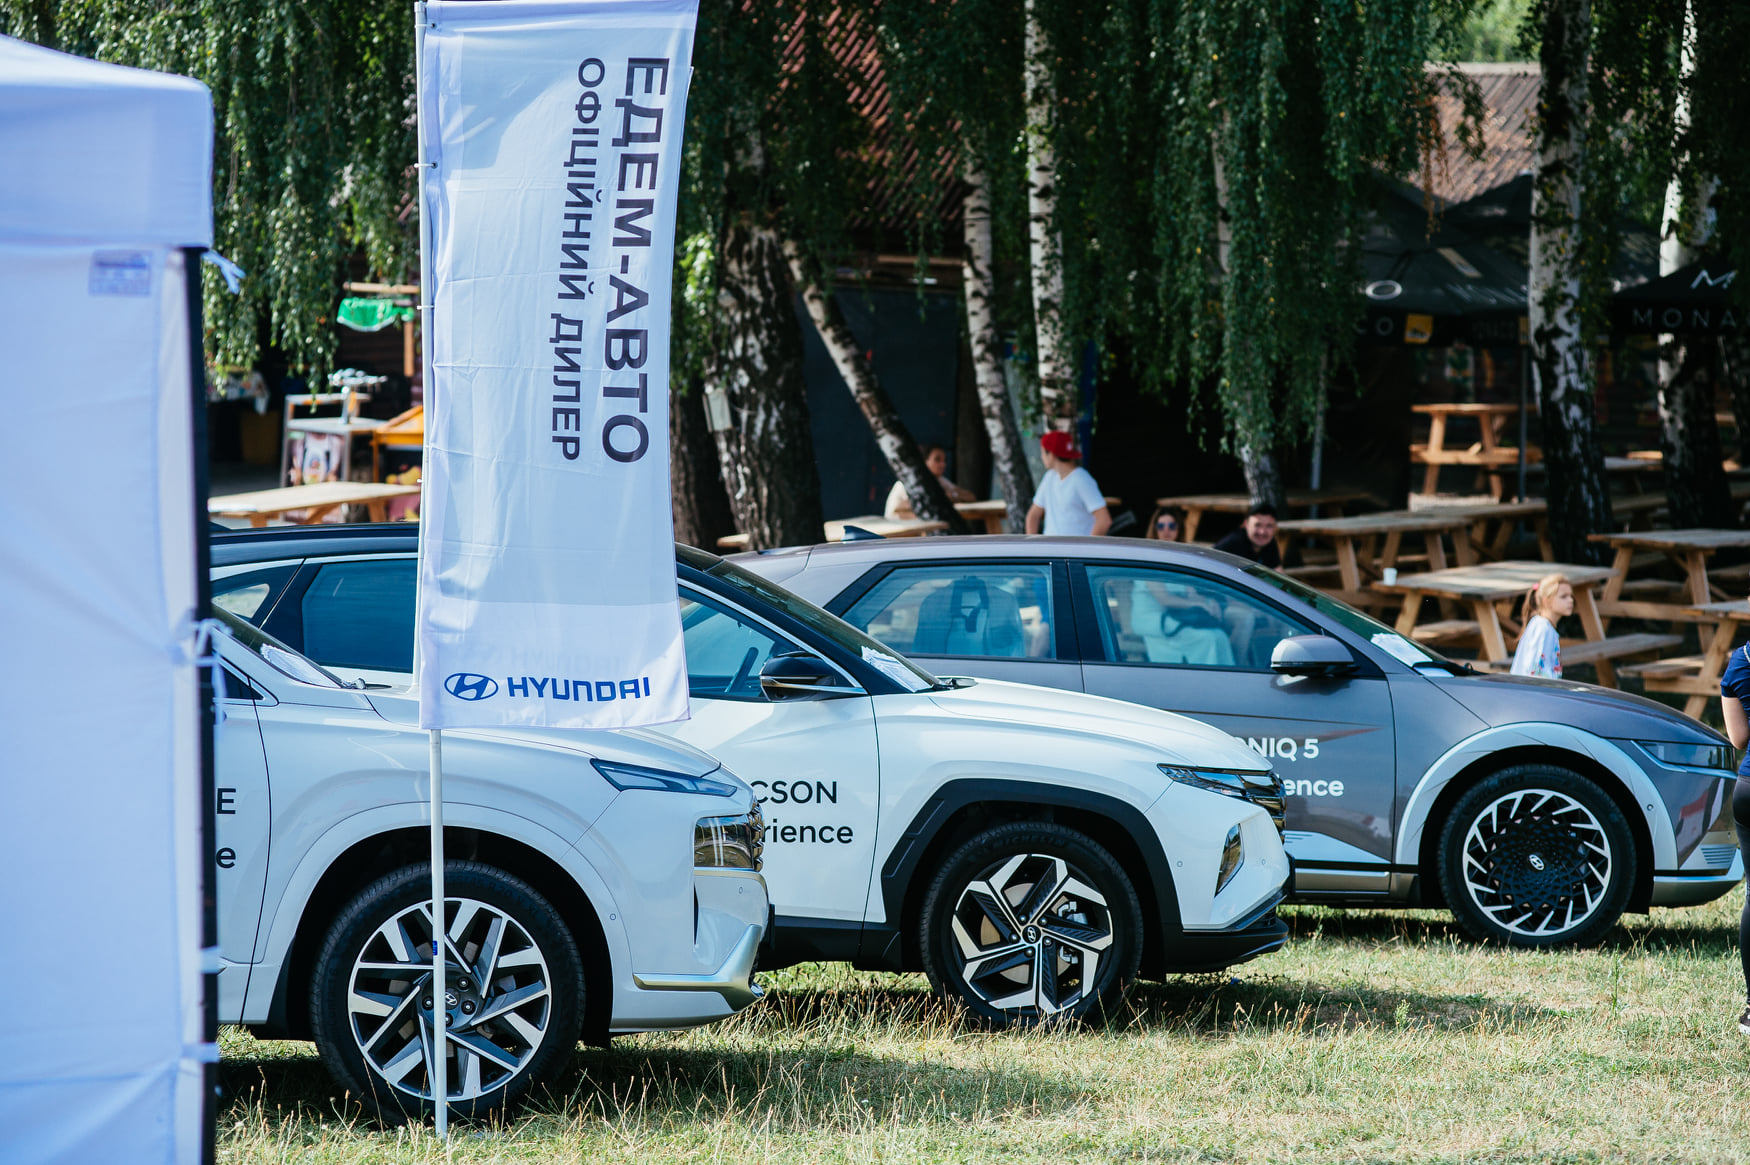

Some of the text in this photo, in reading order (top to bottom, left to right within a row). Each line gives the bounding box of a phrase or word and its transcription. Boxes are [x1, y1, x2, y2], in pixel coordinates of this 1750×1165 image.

[549, 57, 606, 461] ОФІЦІЙНИЙ ДИЛЕР
[602, 57, 670, 463] ЕДЕМ-АВТО
[1631, 306, 1750, 329] MONA
[506, 676, 651, 702] HYUNDAI
[1303, 738, 1320, 759] 5
[1277, 774, 1344, 797] ence
